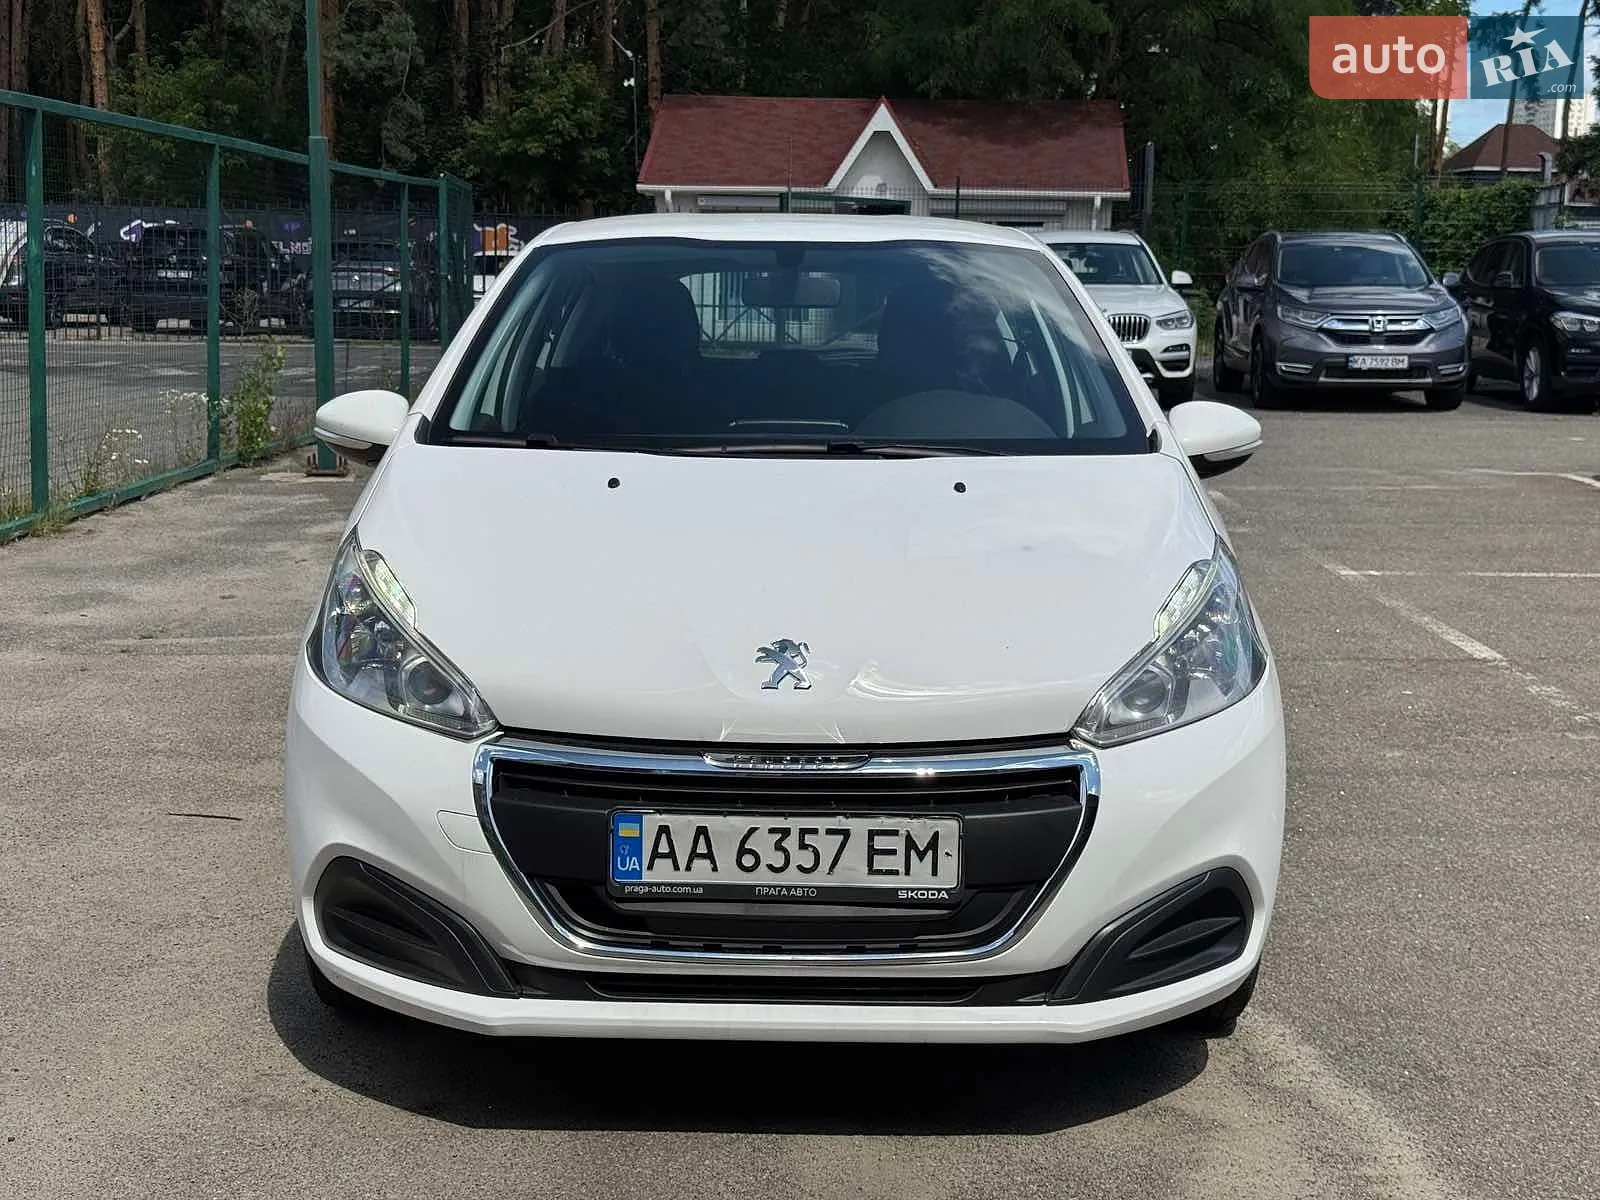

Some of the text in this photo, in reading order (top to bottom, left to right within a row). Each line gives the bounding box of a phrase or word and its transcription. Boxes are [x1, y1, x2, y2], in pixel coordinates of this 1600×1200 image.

[646, 824, 940, 877] AA 6357 EM
[617, 856, 641, 871] UA
[624, 885, 704, 896] praga-auto.com.ua
[755, 886, 817, 897] ПРАГА АВТО
